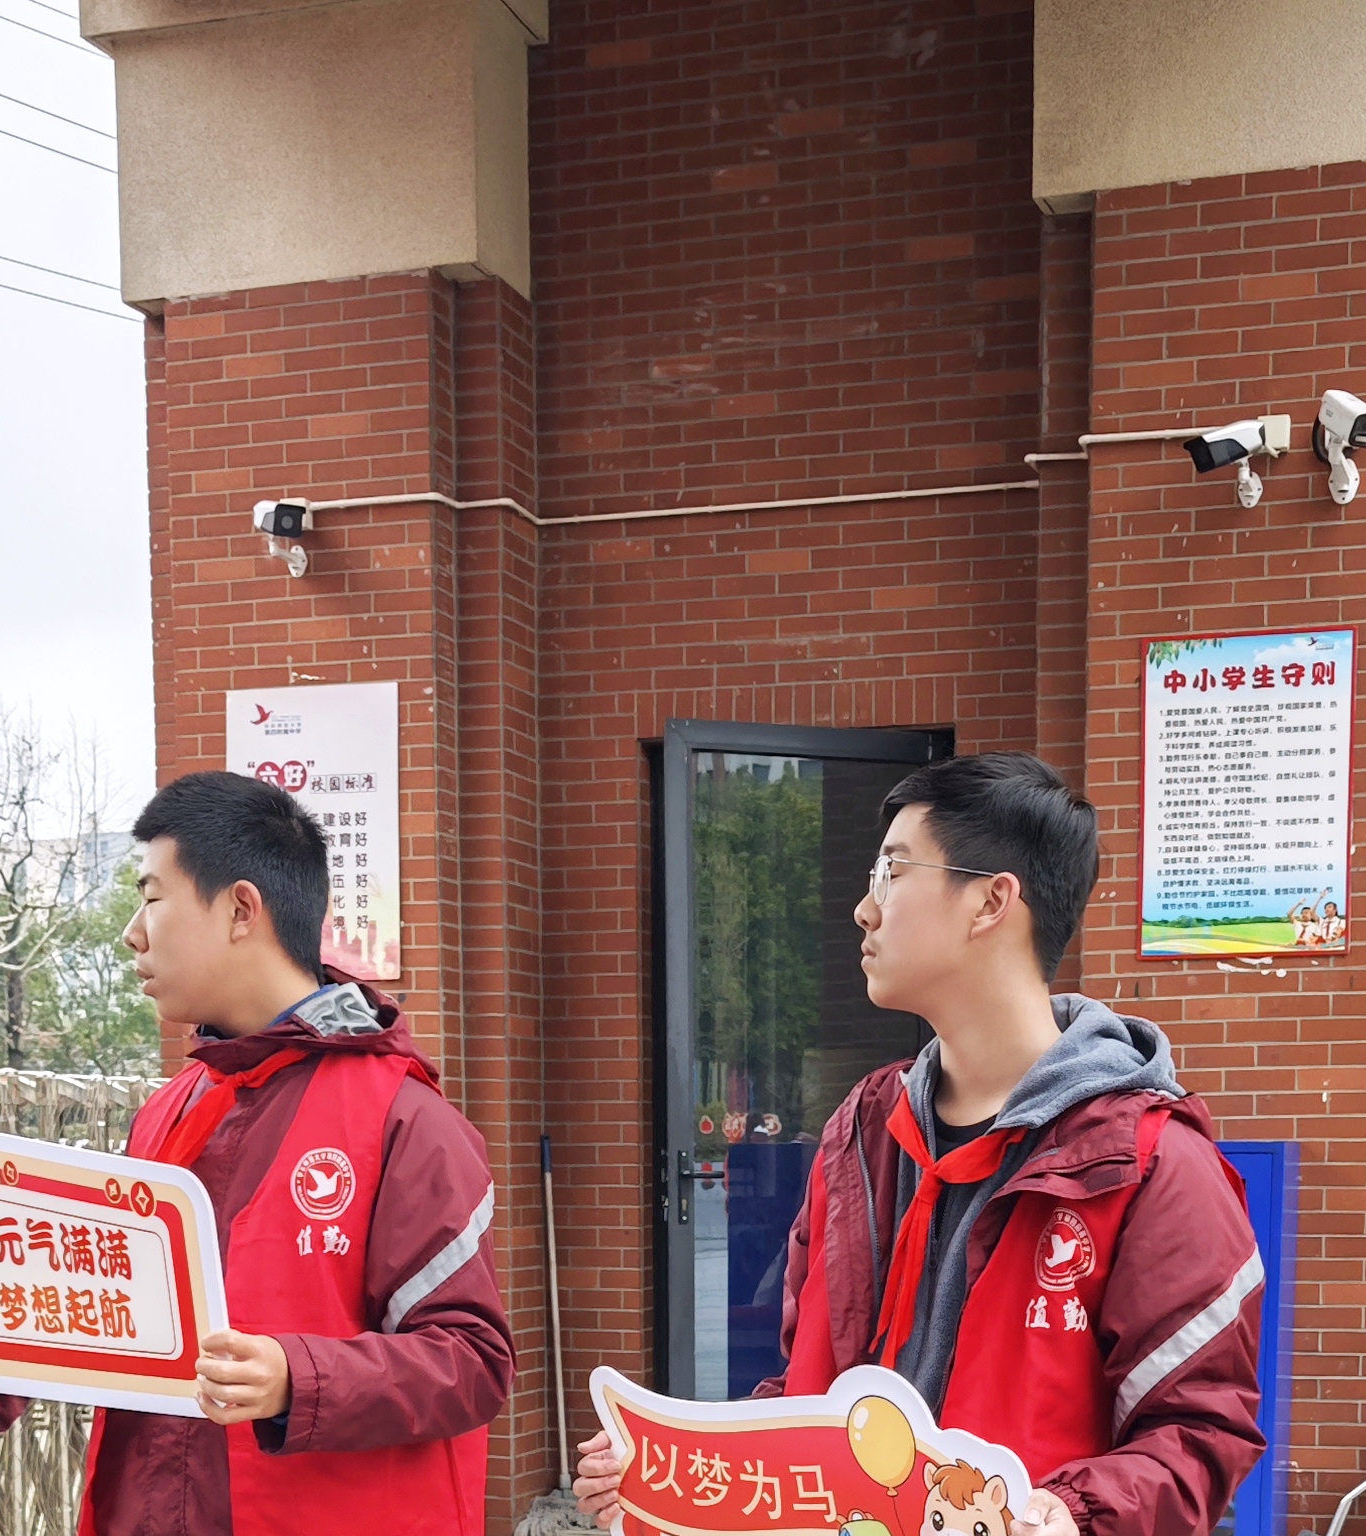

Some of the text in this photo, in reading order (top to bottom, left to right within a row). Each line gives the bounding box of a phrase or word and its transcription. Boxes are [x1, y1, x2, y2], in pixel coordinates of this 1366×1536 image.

[1163, 660, 1336, 693] 中小学生守则
[296, 1225, 351, 1256] 值勤
[1025, 1295, 1088, 1332] 值勤
[639, 1435, 836, 1523] 以梦为马
